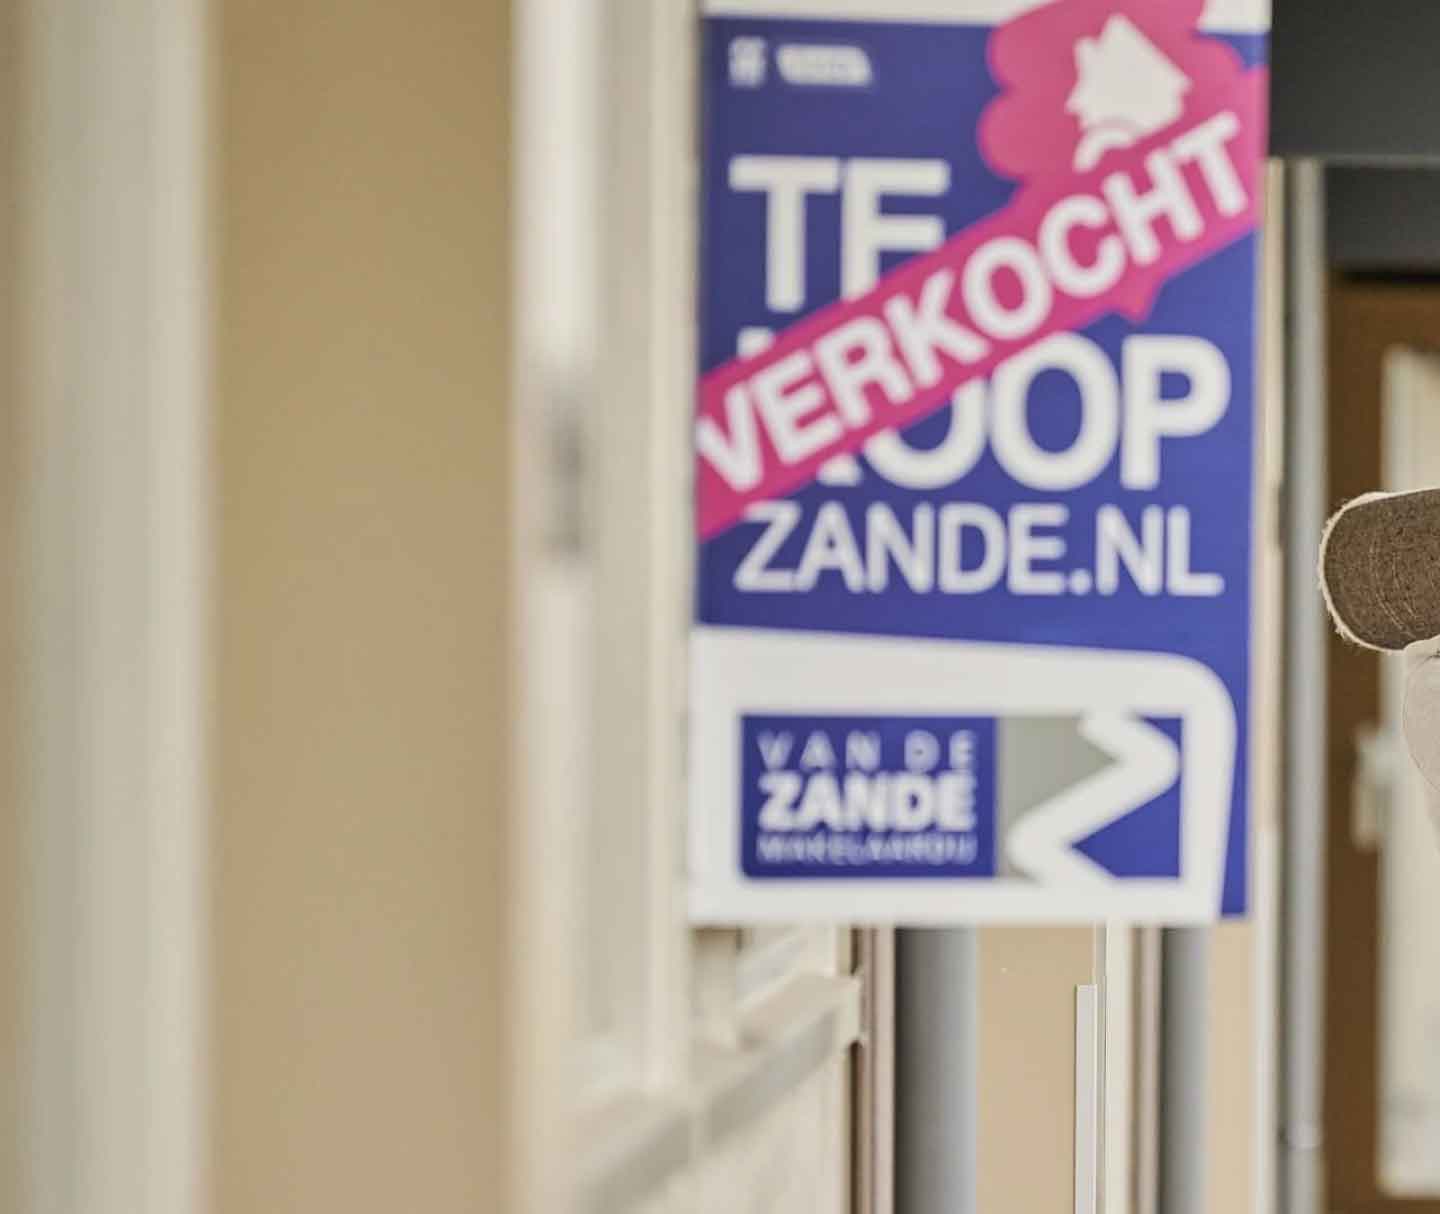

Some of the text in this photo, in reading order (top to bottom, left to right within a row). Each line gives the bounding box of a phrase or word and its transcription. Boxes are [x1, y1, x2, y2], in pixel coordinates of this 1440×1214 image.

[696, 110, 1249, 493] VERKOCHT
[737, 327, 1232, 491] OOP
[732, 499, 1225, 597] ZANDE.NL
[756, 730, 977, 770] VAN DE
[757, 769, 977, 832] ZANDE
